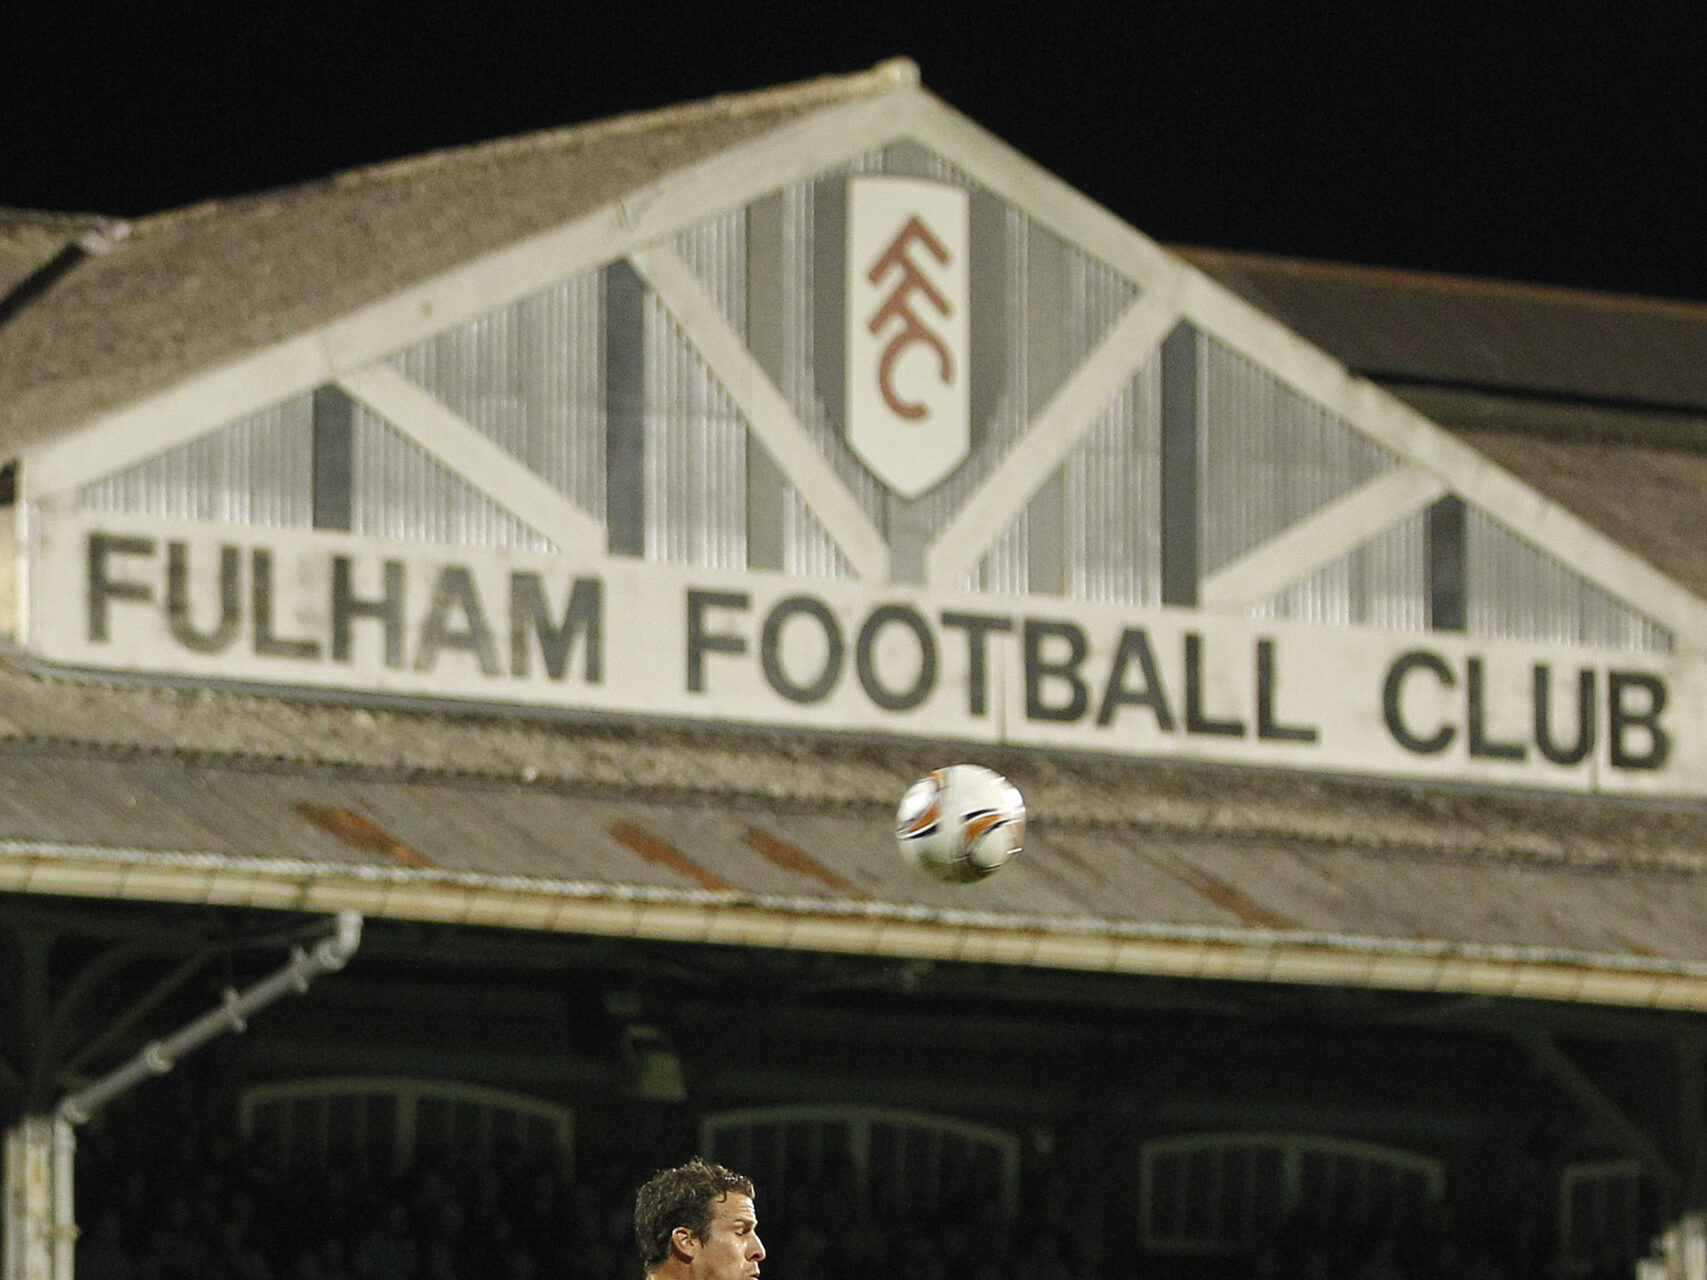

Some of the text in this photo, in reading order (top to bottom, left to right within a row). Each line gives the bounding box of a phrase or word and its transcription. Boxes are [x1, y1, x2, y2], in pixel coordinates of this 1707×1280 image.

[87, 532, 1671, 771] FULHAM FOOTBALL CLUB
